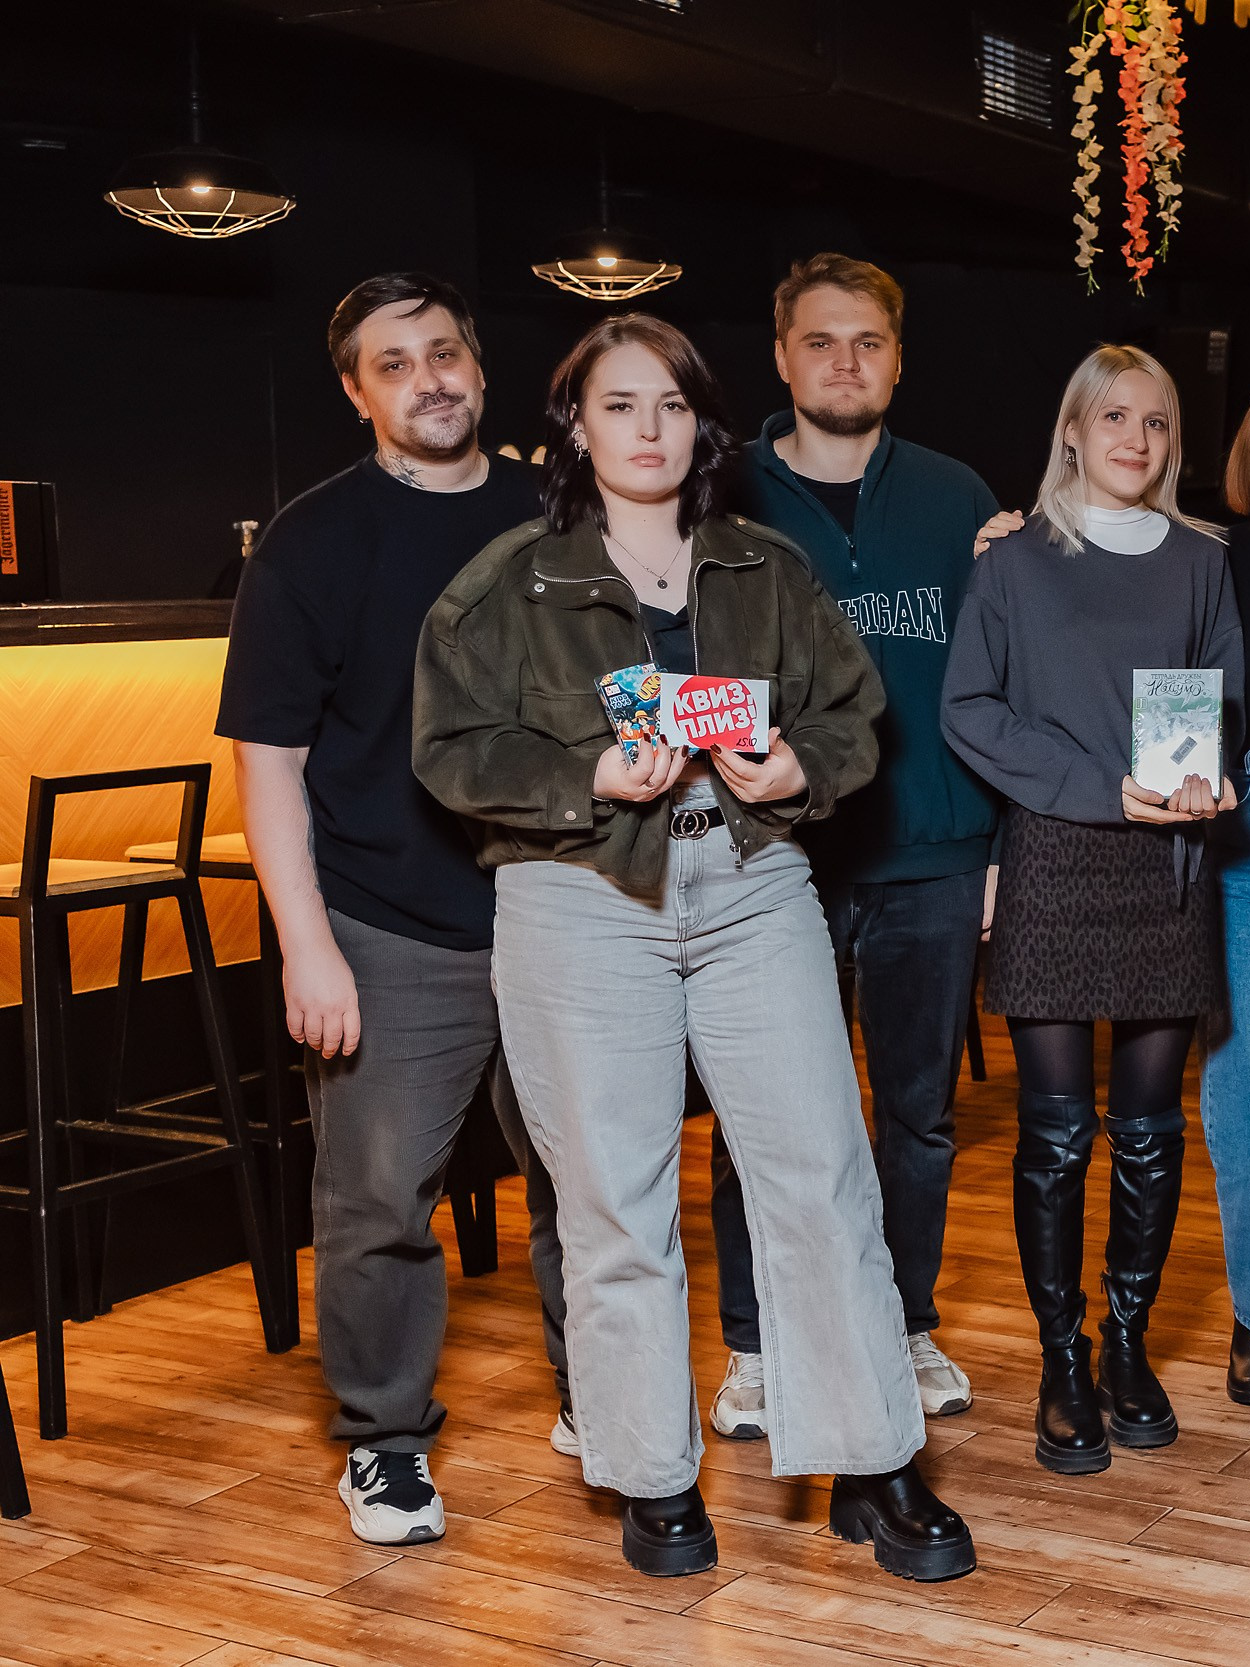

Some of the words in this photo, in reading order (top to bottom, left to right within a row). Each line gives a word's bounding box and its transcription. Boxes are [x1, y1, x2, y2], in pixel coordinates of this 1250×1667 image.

[609, 693, 628, 704] KIDS
[636, 673, 662, 702] UNO
[675, 682, 755, 716] КВИЗ,
[611, 699, 632, 709] TOYS
[677, 705, 758, 739] ПЛИЗ!
